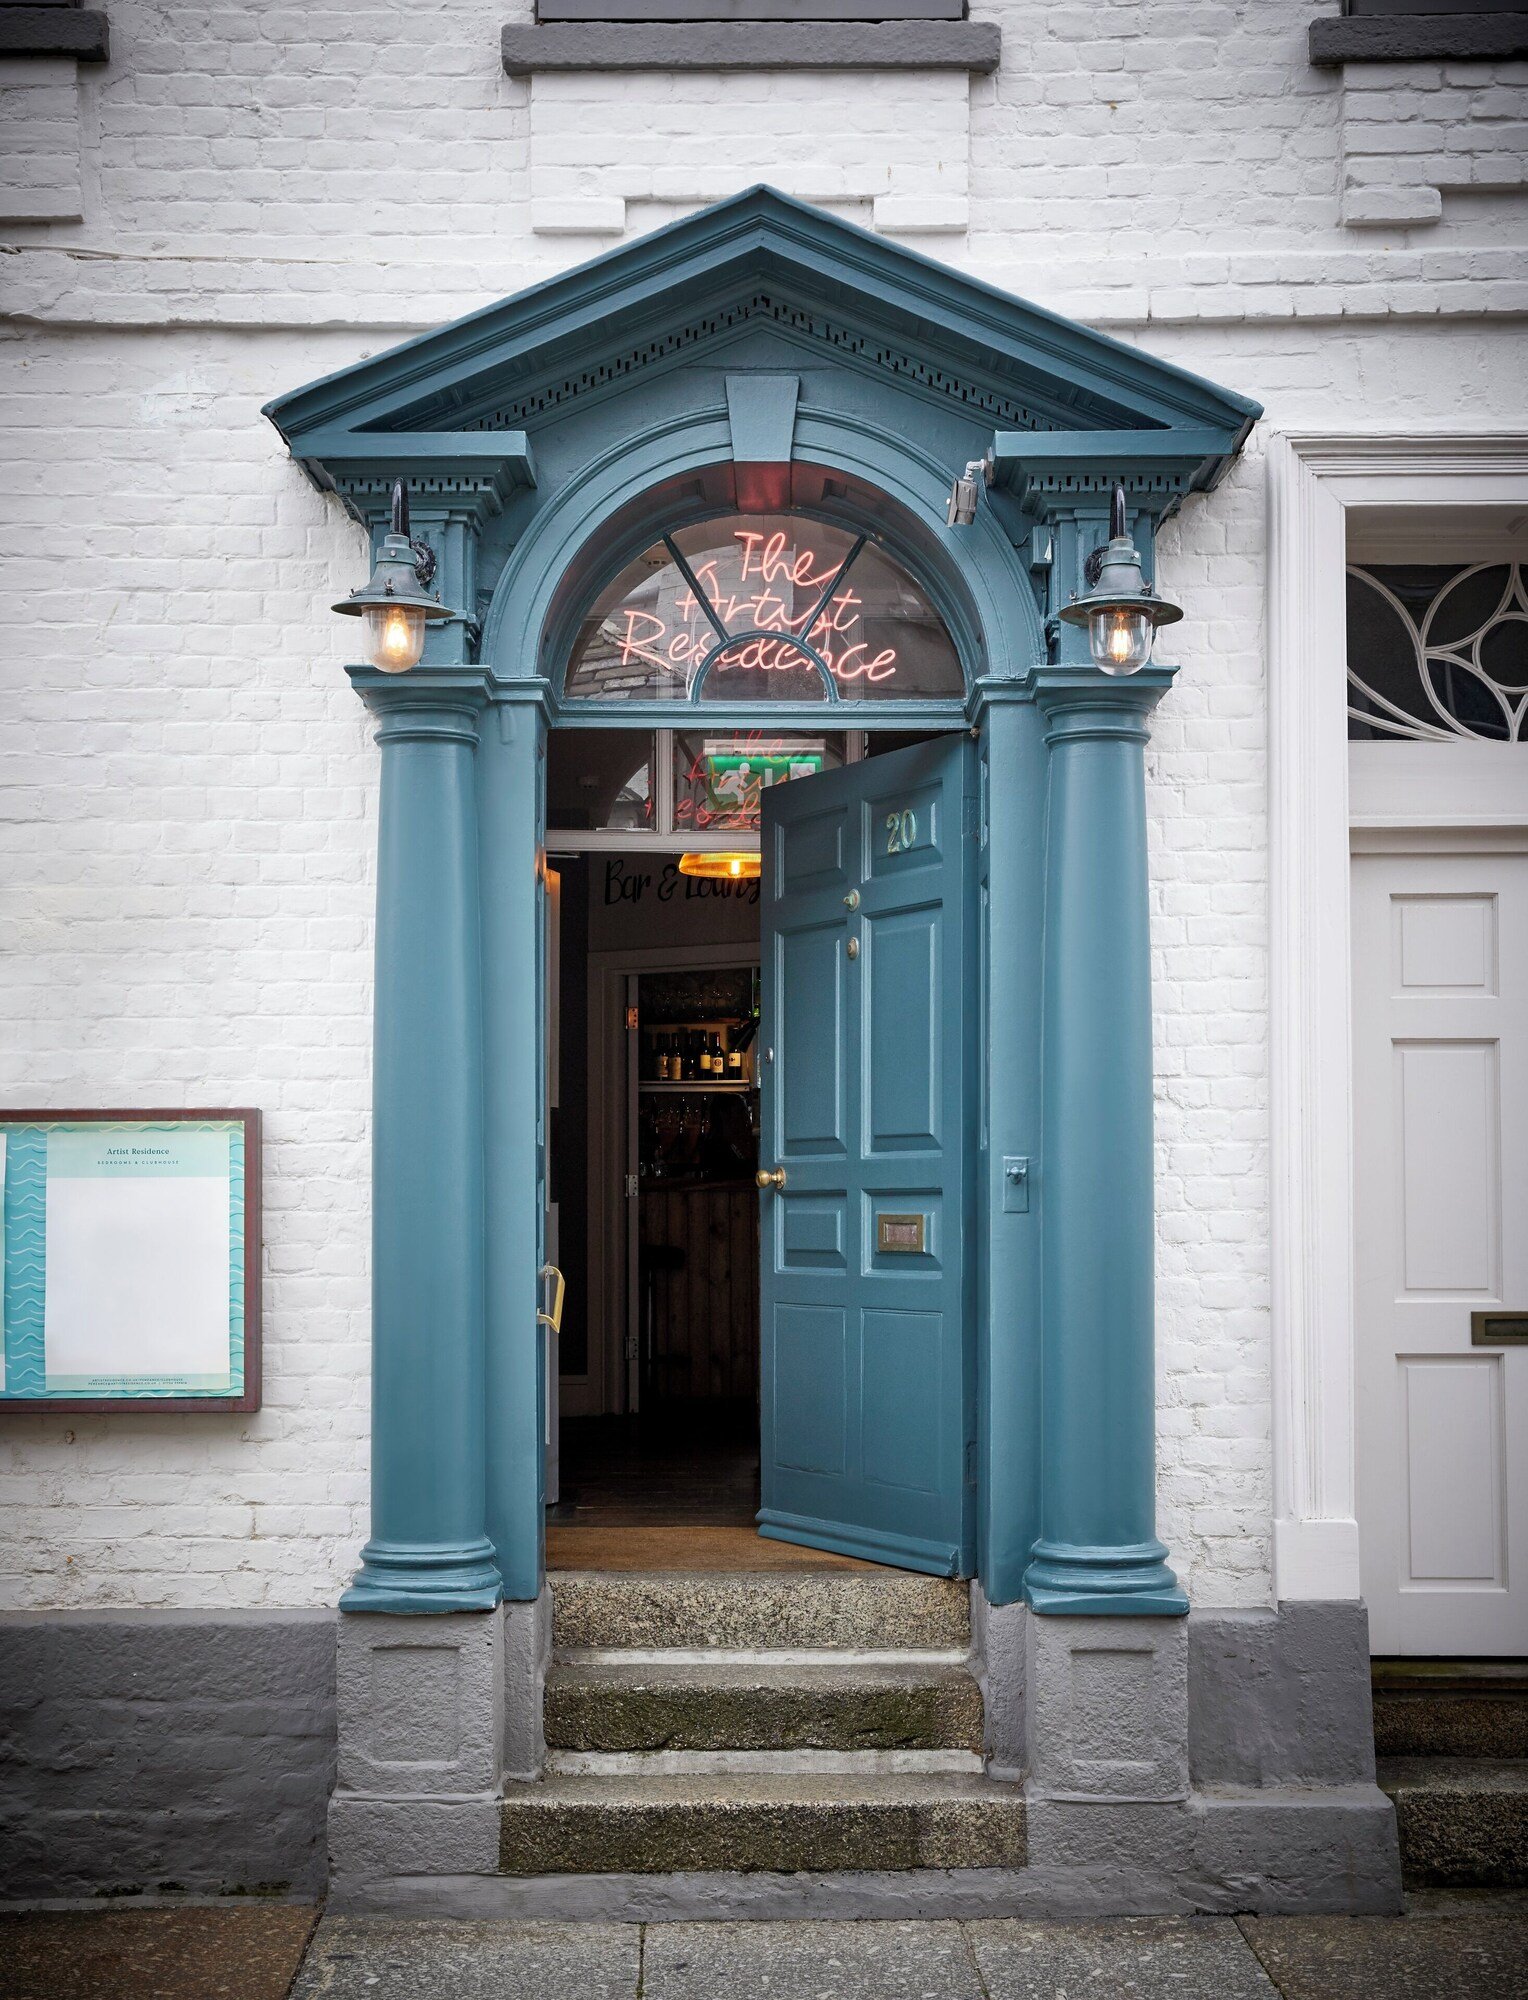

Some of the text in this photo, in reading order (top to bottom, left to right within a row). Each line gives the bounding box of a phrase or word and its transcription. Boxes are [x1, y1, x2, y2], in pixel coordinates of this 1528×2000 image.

[733, 531, 846, 587] The
[675, 561, 862, 638] Artist
[617, 610, 897, 682] Residence
[886, 809, 917, 853] 20
[604, 859, 762, 906] Bar & Loung
